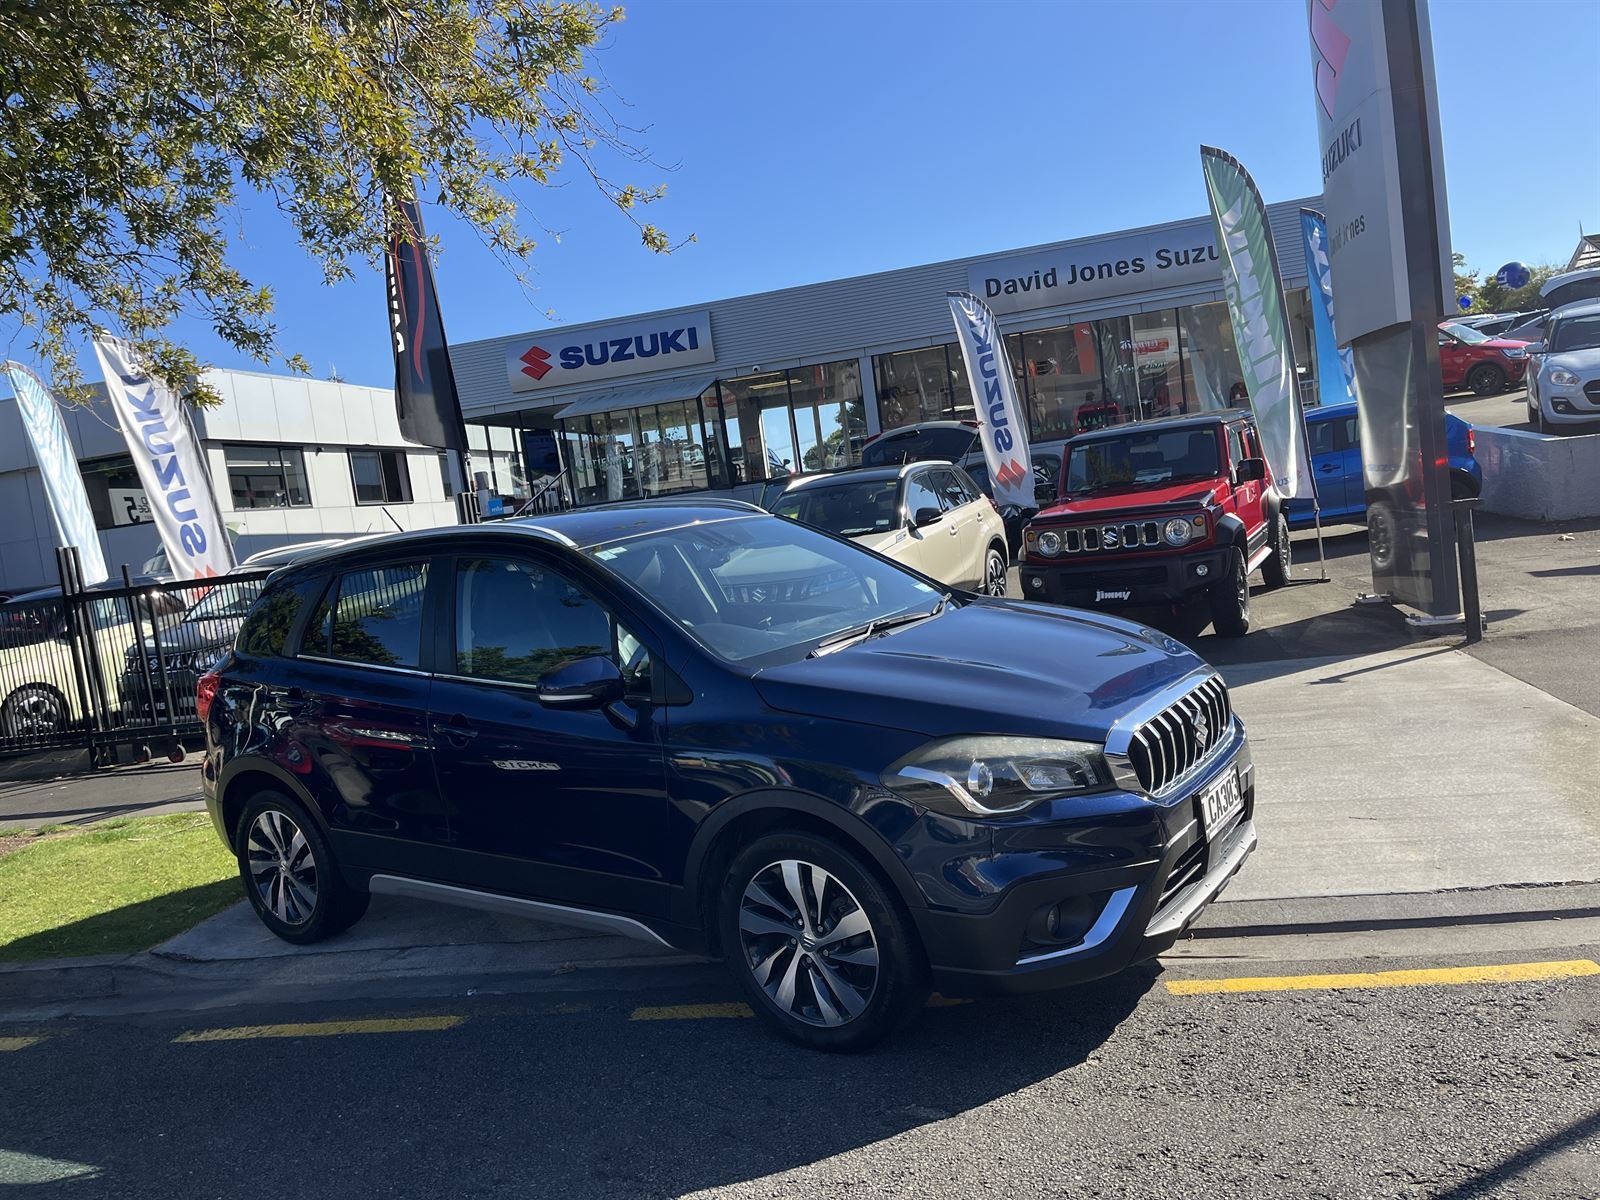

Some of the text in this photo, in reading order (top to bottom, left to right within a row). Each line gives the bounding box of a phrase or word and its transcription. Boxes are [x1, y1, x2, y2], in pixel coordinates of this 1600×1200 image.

[984, 267, 1058, 298] David
[1067, 256, 1146, 285] Jones
[559, 326, 699, 370] SUZUKI
